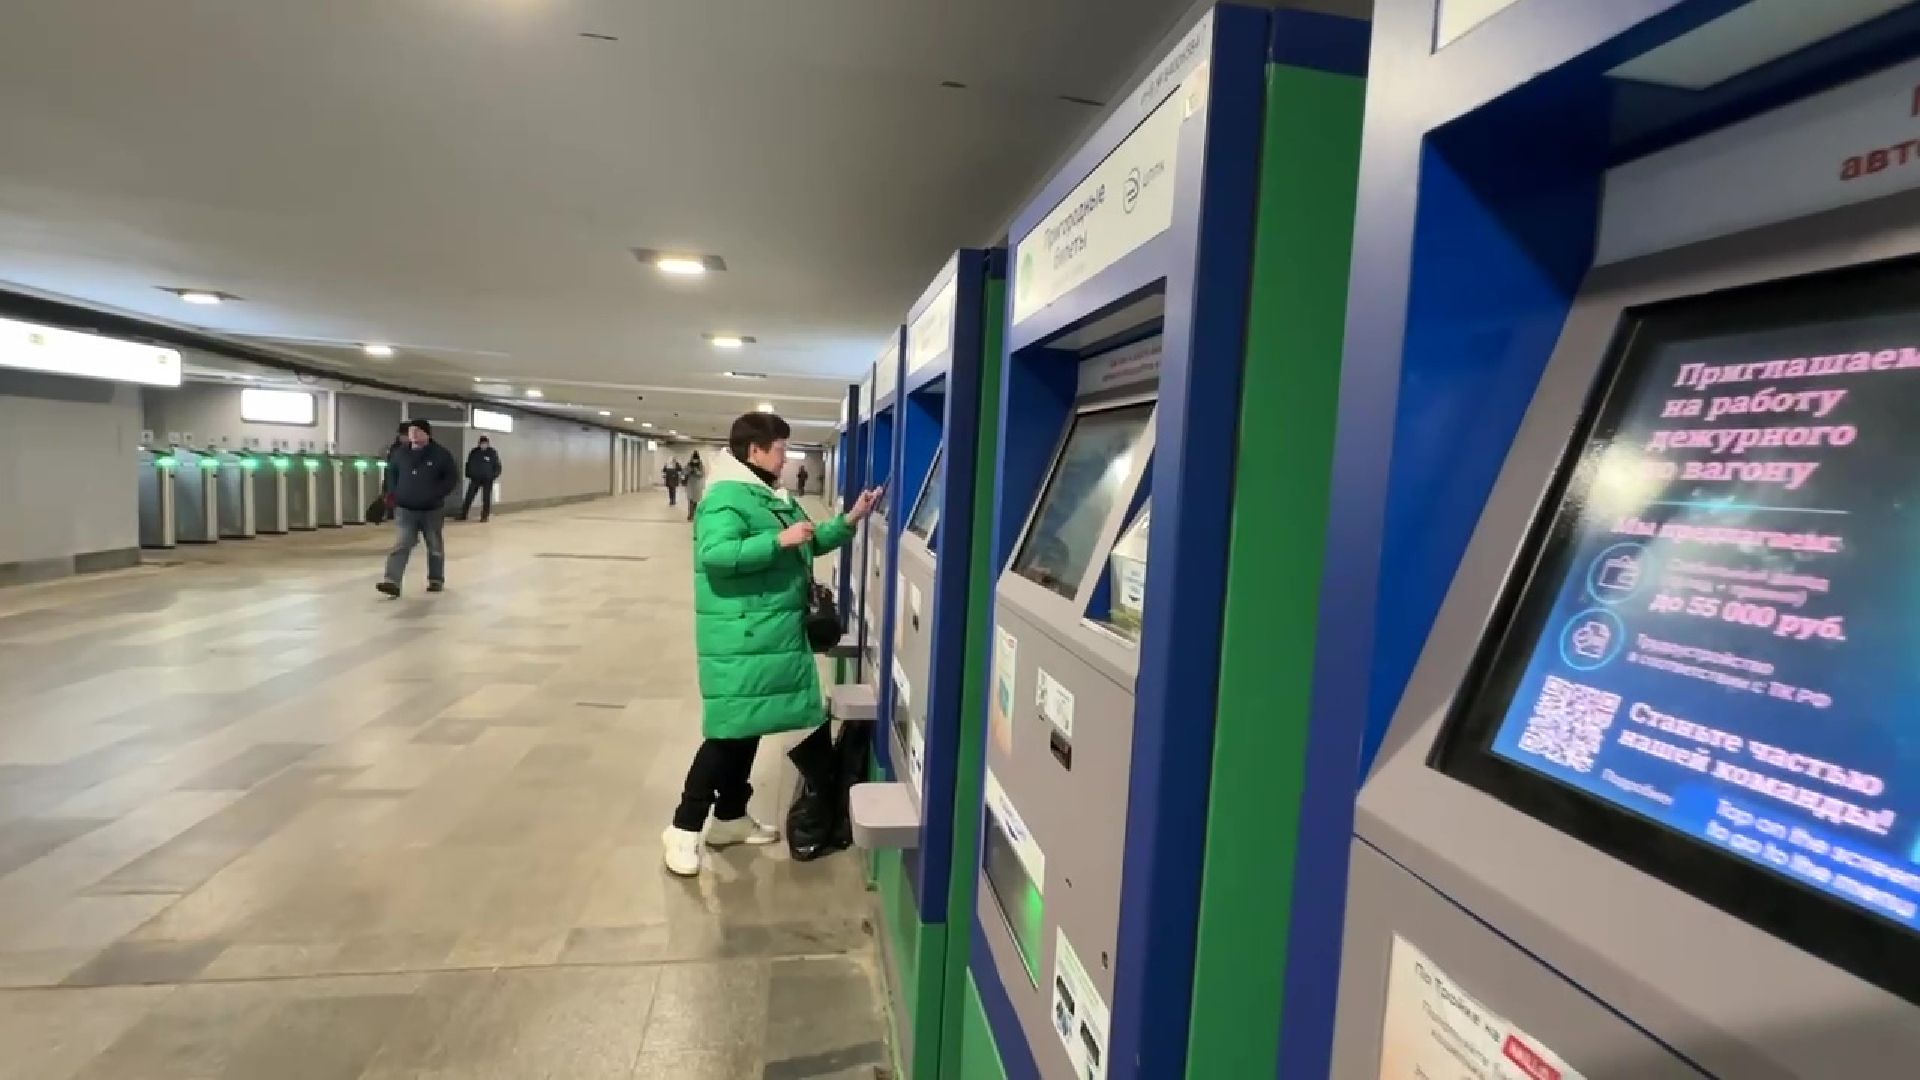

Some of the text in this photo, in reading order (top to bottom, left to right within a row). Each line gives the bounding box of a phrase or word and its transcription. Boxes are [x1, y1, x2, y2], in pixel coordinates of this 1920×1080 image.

[1660, 387, 1848, 421] на работу
[1647, 425, 1857, 454] дежурного
[1681, 461, 1820, 490] вагону
[1687, 597, 1720, 617] 55
[1722, 602, 1776, 628] 000
[1773, 615, 1846, 640] руб.
[1617, 730, 1710, 773] нашей
[1630, 703, 1884, 796] Станьте частью
